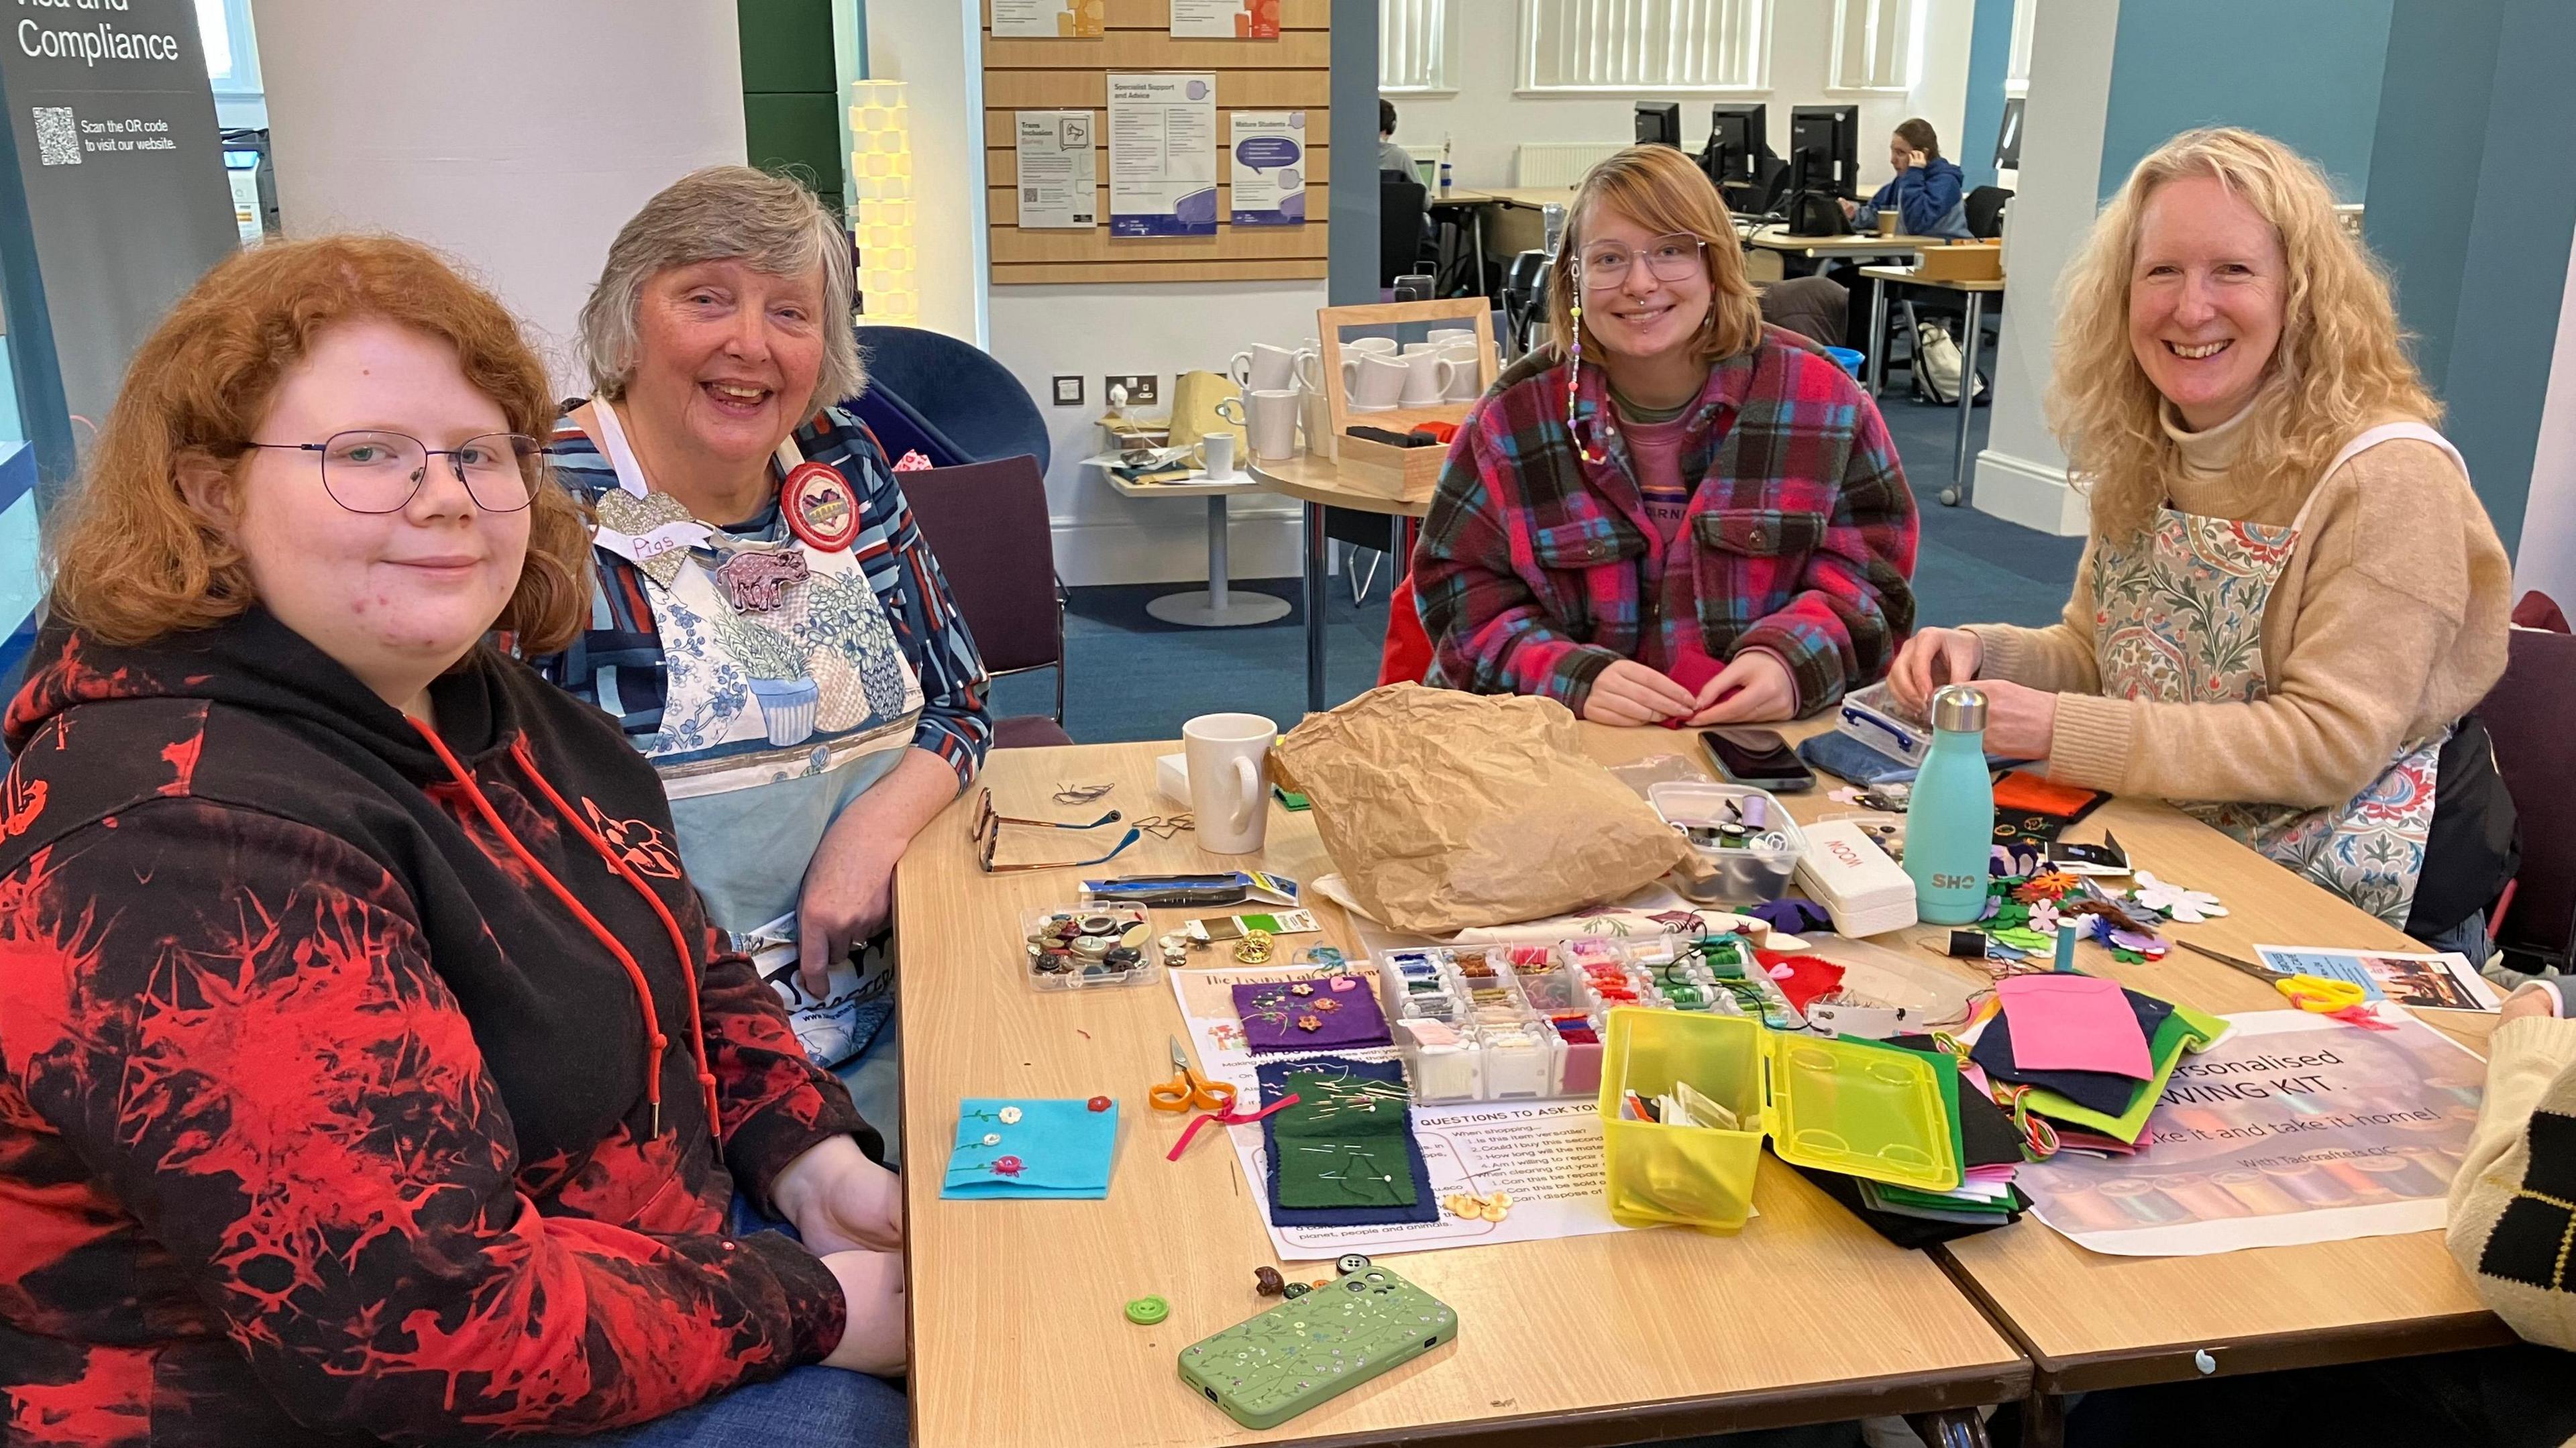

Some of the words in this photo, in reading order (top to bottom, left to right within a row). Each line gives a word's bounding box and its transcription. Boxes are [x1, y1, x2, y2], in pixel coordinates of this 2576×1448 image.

[18, 19, 178, 67] Compliance
[81, 120, 105, 133] Scan
[107, 120, 123, 132] the
[125, 119, 143, 132] QR
[144, 119, 168, 131] code
[85, 139, 95, 152] to
[97, 138, 117, 151] visit
[118, 141, 134, 150] our
[136, 137, 176, 150] website.
[633, 537, 674, 558] Pigs
[1205, 975, 1230, 985] The
[2155, 1080, 2269, 1107] WING
[2270, 1075, 2334, 1095] KIT
[1421, 1112, 1508, 1127] QUESTIONS
[1511, 1110, 1533, 1118] TO
[1538, 1107, 1570, 1116] ASK
[2188, 1129, 2214, 1141] it
[2216, 1123, 2265, 1140] and
[2268, 1121, 2328, 1137] take
[2329, 1117, 2353, 1129] it
[2352, 1107, 2441, 1128] home!
[1536, 1128, 1586, 1137] versatile?
[1520, 1141, 1539, 1149] buy
[1565, 1135, 1603, 1144] second
[1511, 1150, 1536, 1158] long
[1517, 1158, 1549, 1166] willing
[1566, 1154, 1597, 1162] repair
[2237, 1158, 2280, 1168] With
[2279, 1150, 2367, 1164] Tadcrafters
[2368, 1146, 2398, 1156] CIC
[1477, 1170, 1507, 1178] When
[1509, 1166, 1553, 1174] clearing
[1576, 1162, 1602, 1170] your
[1527, 1174, 1547, 1182] this
[1533, 1184, 1554, 1192] this
[1544, 1190, 1589, 1200] dispose
[1299, 1232, 1338, 1240] planet,
[1340, 1228, 1379, 1237] people
[1382, 1225, 1403, 1233] and
[1406, 1221, 1453, 1231] animals.
